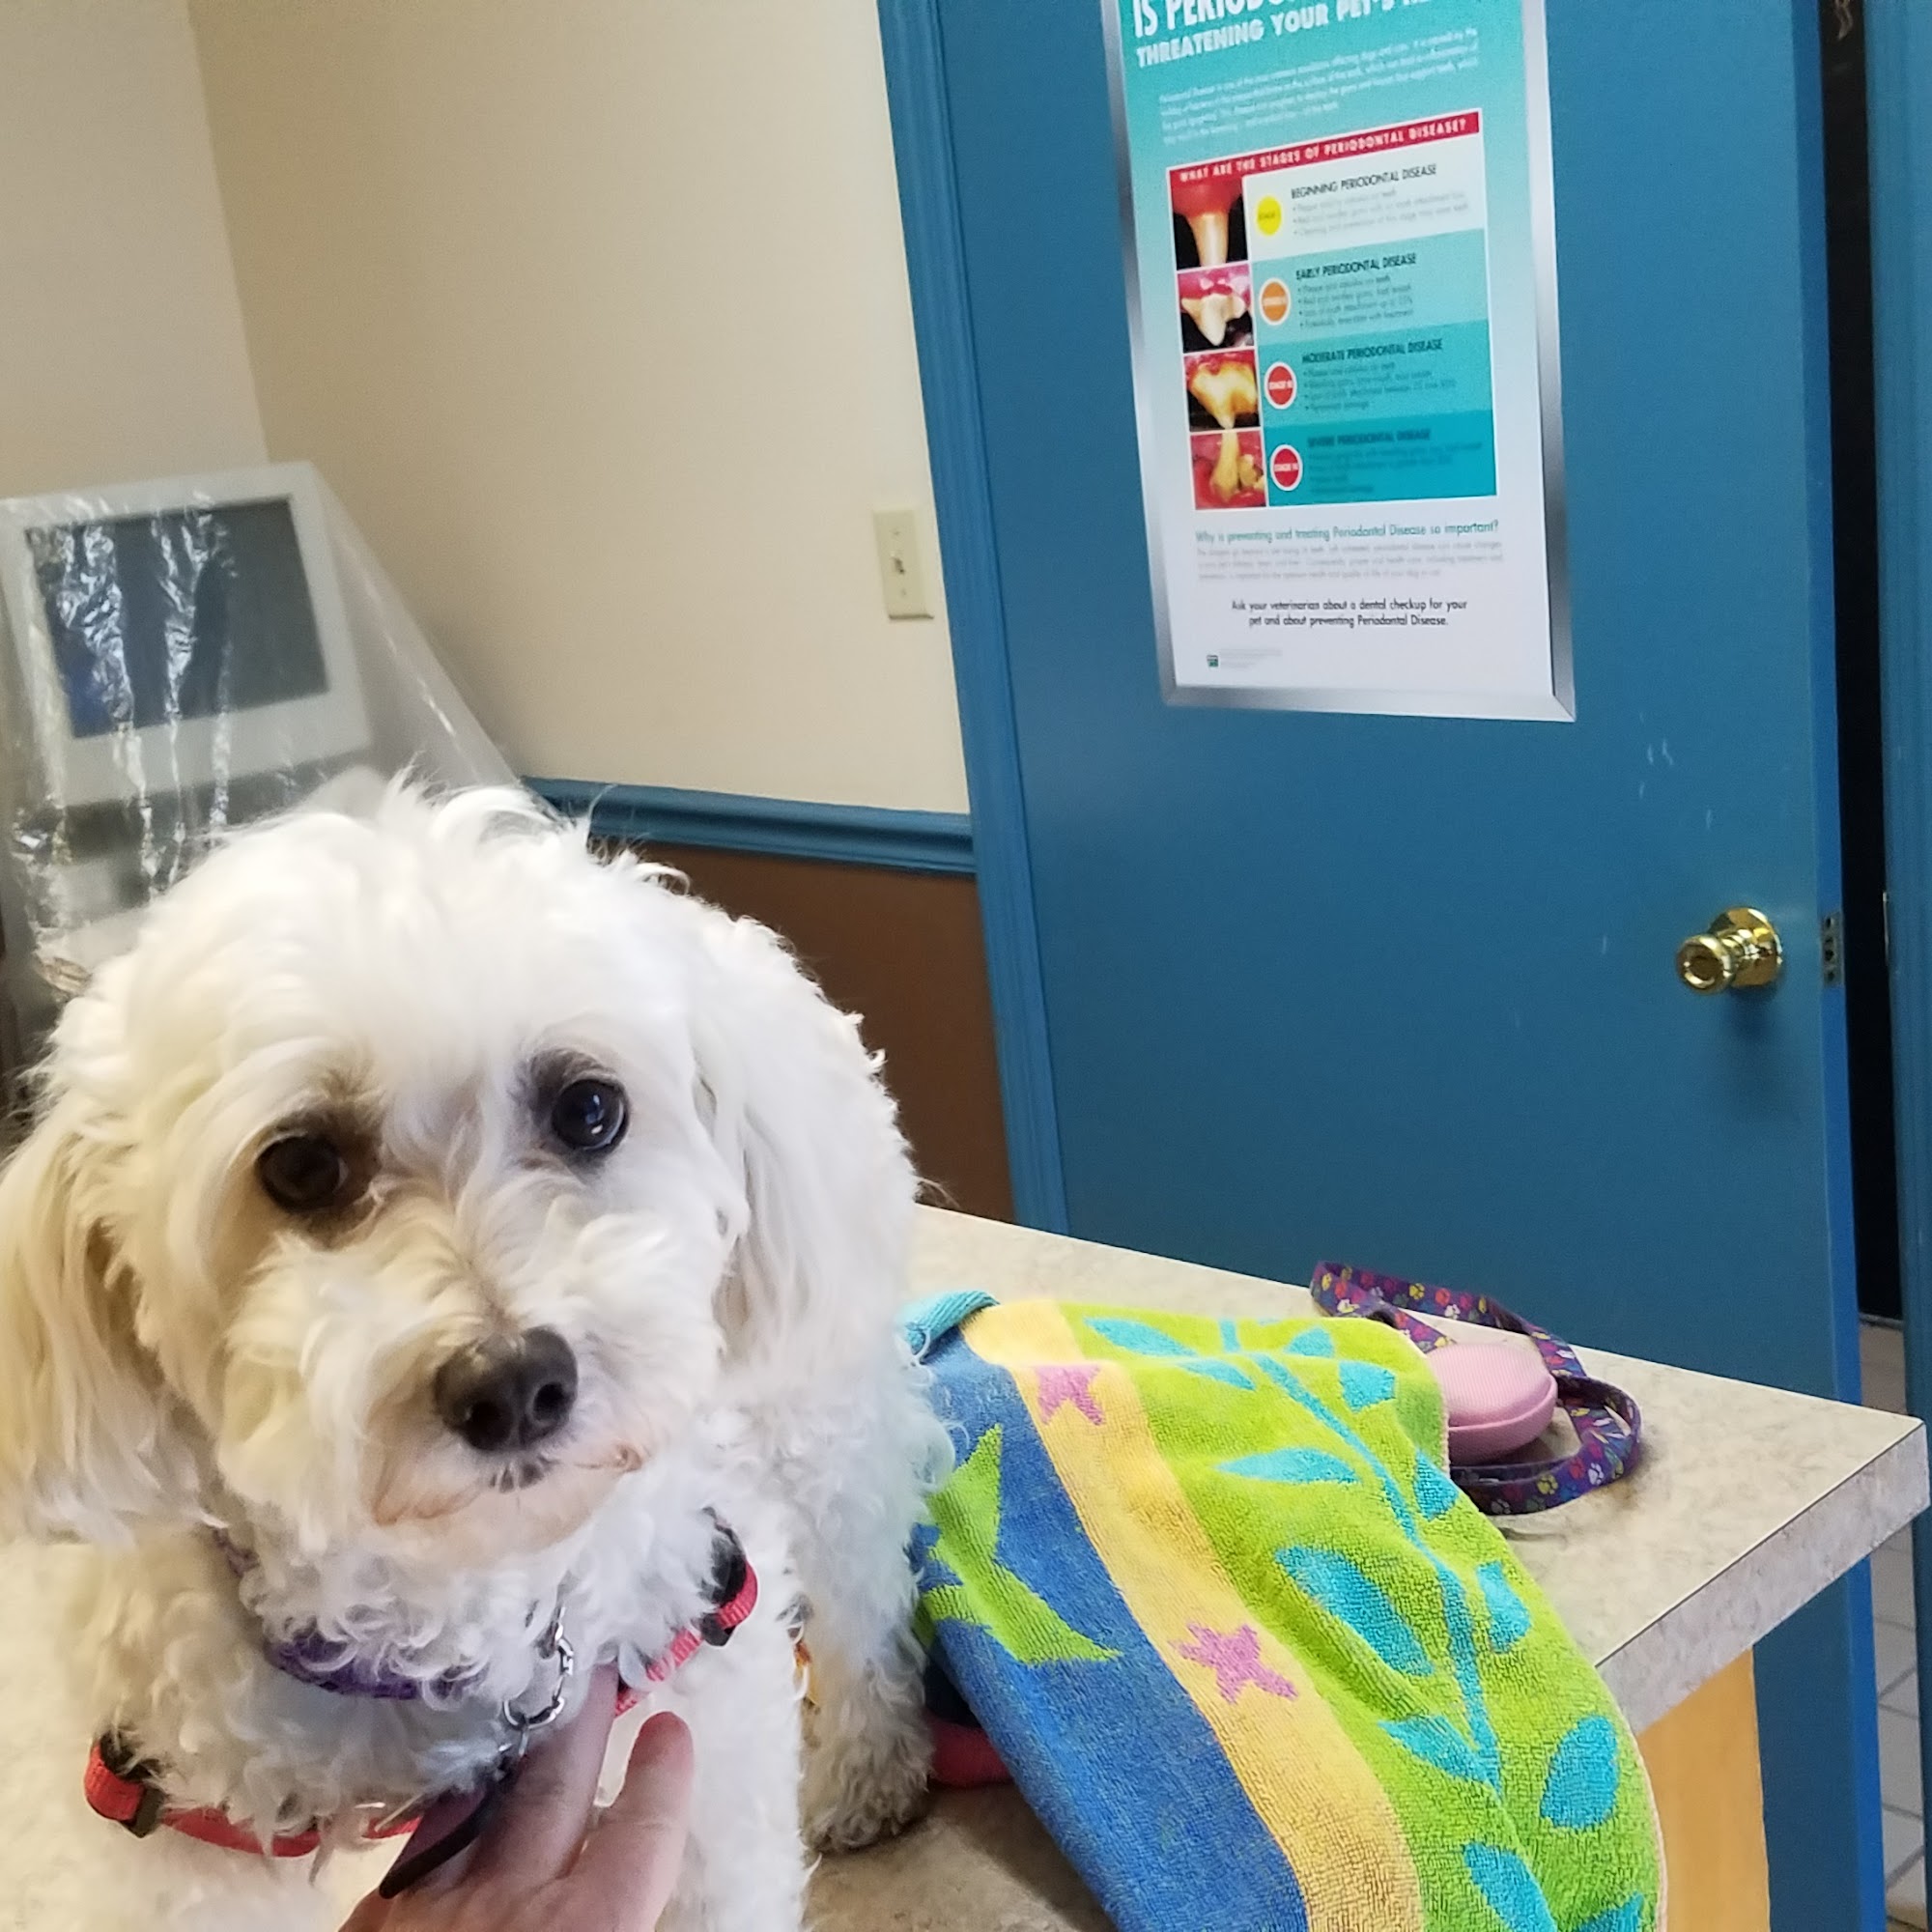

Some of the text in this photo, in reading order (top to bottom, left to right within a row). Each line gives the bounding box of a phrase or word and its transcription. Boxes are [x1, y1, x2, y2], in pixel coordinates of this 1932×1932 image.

[1133, 0, 1158, 38] IS
[1137, 19, 1264, 68] THREATENING
[1270, 4, 1328, 36] YOUR
[1180, 167, 1208, 183] WHAT
[1212, 162, 1232, 176] ARE
[1236, 157, 1255, 172] THE
[1260, 150, 1300, 167] STAGES
[1305, 145, 1320, 159] OF
[1324, 130, 1404, 156] PERIODONTAL
[1291, 163, 1436, 199] BEGINNING PERIODONTAL DISEASE
[1295, 252, 1416, 280] EARLY PERIODONTAL DISEASE
[1302, 338, 1442, 363] MODERATE PERIODONTAL DISEASE
[1195, 529, 1214, 543] Why
[1227, 531, 1272, 544] preventing
[1275, 527, 1292, 540] and
[1295, 527, 1330, 542] treating
[1333, 524, 1385, 537] Periodontal
[1390, 524, 1426, 535] Disease
[1431, 526, 1440, 534] so
[1445, 520, 1498, 536] important?
[1232, 599, 1246, 610] Ask
[1249, 603, 1267, 612] your
[1269, 599, 1320, 610] veterinarian
[1322, 598, 1347, 610] about
[1359, 597, 1386, 610] dental
[1390, 597, 1427, 612] checkup
[1430, 597, 1442, 610] for
[1446, 602, 1467, 612] your
[1249, 613, 1449, 629] pet and about preventing Periodontal Disease.
